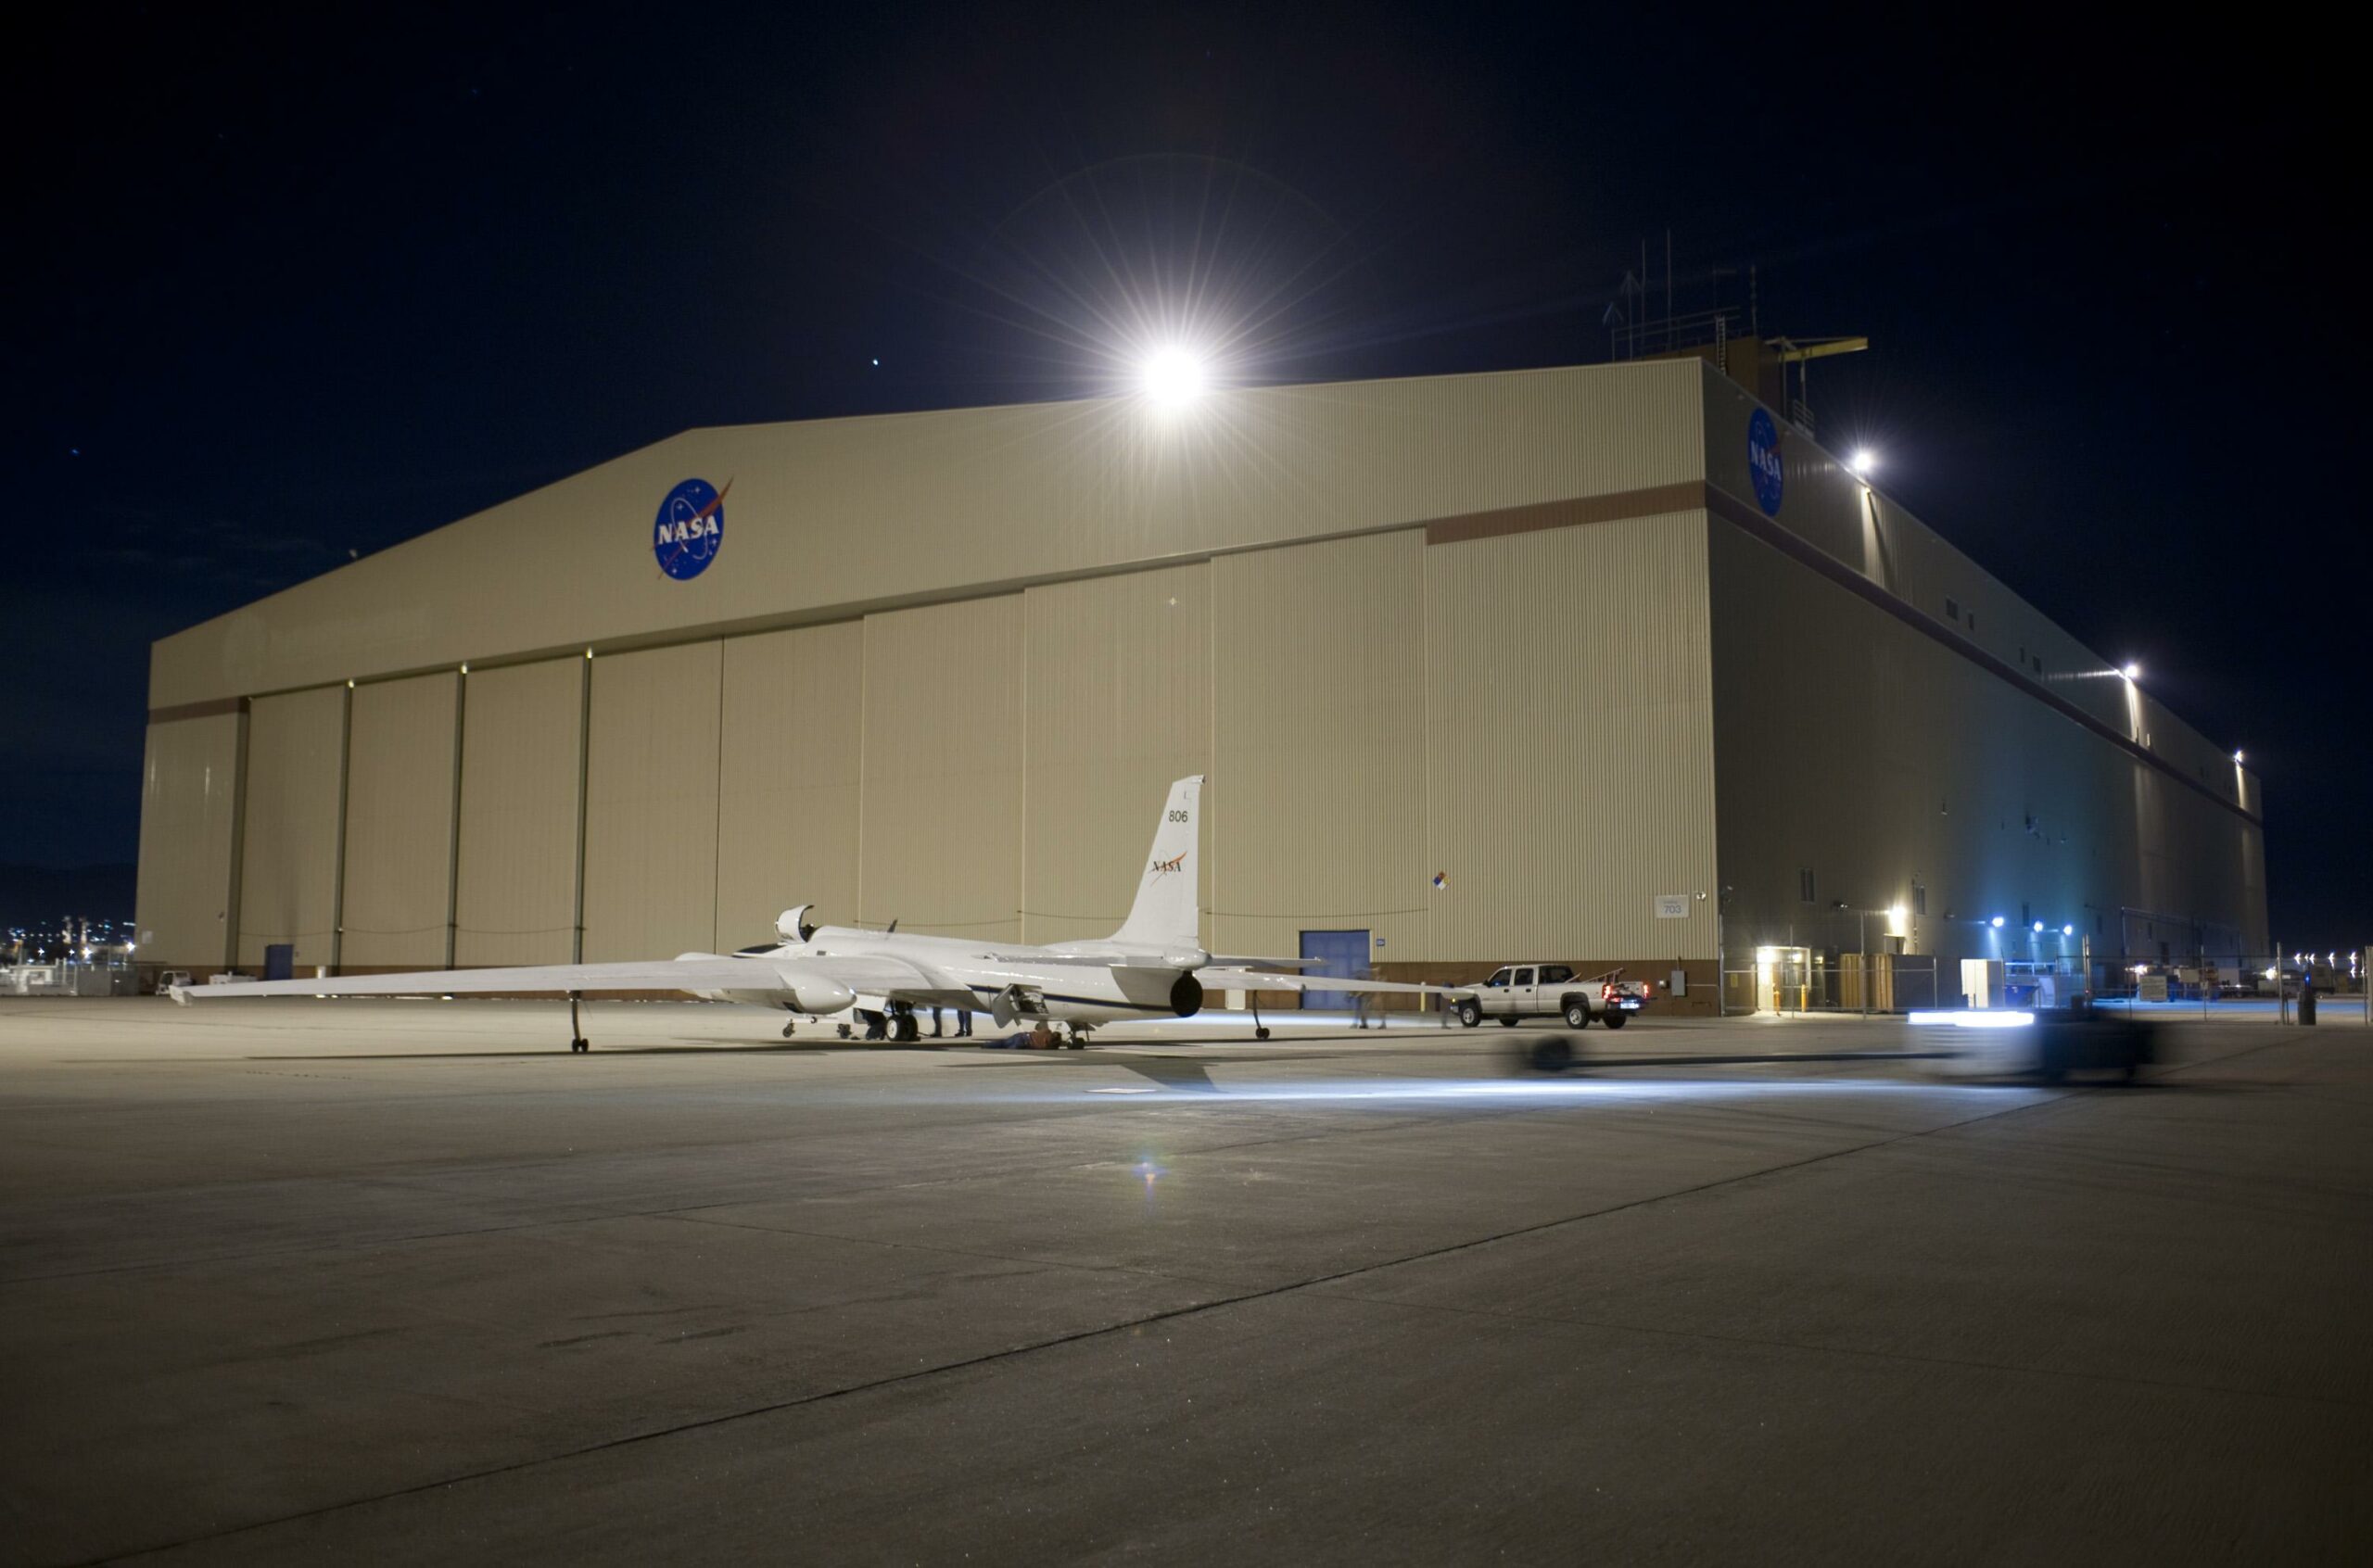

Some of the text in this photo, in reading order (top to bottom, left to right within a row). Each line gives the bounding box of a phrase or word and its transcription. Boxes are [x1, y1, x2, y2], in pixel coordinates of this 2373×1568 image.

[1750, 439, 1782, 481] NASA
[658, 515, 719, 545] NASA
[1169, 810, 1188, 823] 806
[1153, 861, 1181, 872] NASA
[1664, 905, 1681, 914] 703
